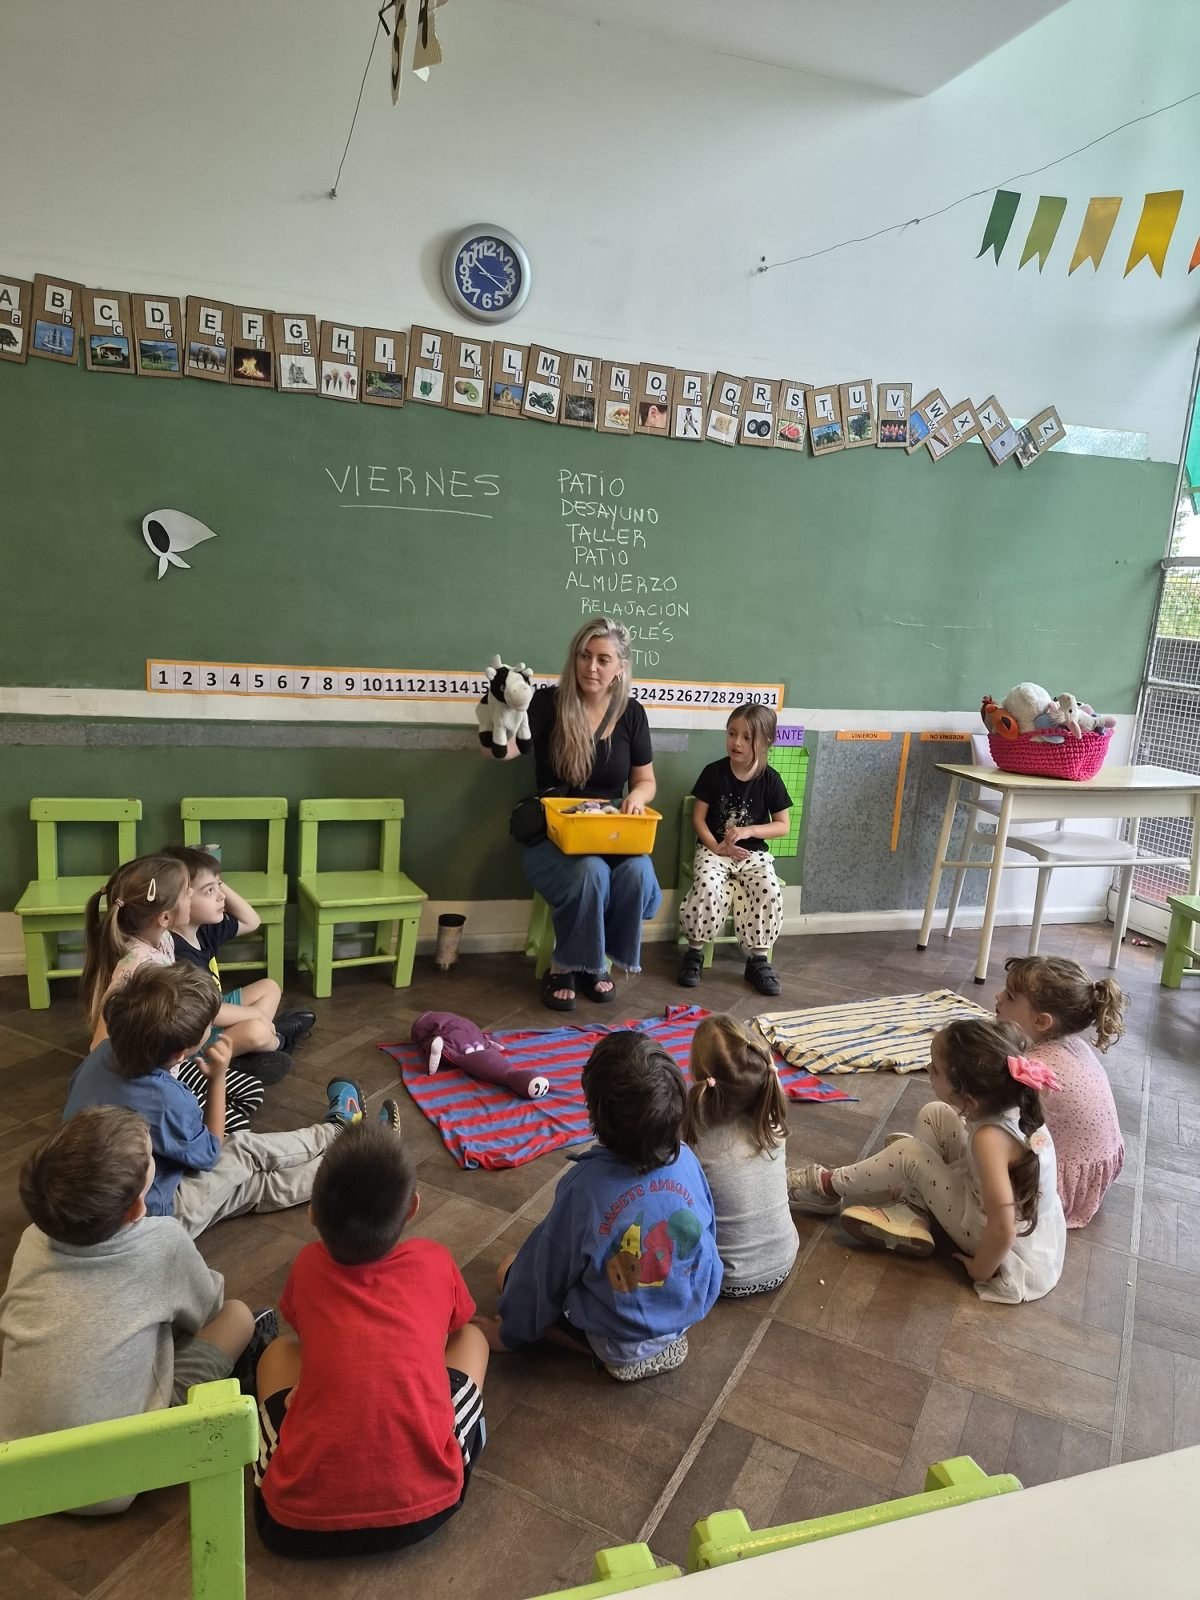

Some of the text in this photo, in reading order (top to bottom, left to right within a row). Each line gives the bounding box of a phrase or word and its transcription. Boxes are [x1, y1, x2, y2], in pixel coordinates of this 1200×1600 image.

[470, 242, 483, 259] 11
[482, 240, 497, 257] 12
[496, 246, 504, 261] 1
[460, 250, 475, 267] 10
[504, 256, 513, 272] 2
[459, 264, 470, 279] 9
[506, 268, 515, 285] 3
[462, 278, 472, 293] 8
[471, 288, 481, 303] 7
[482, 292, 492, 309] 6
[494, 290, 504, 306] 5
[0, 289, 13, 306] A
[52, 292, 65, 308] B
[100, 305, 113, 320] C
[152, 308, 164, 323] D
[205, 314, 216, 329] E
[248, 320, 258, 334] F
[290, 324, 302, 338] G
[338, 334, 349, 349] H
[427, 340, 436, 354] J
[465, 349, 475, 364] K
[508, 355, 516, 369] L
[542, 357, 554, 374] M
[578, 365, 588, 379] N
[615, 370, 625, 387] Ñ
[651, 377, 662, 390] O
[688, 382, 697, 394] P
[726, 388, 736, 405] Q
[756, 388, 766, 401] R
[791, 394, 800, 406] S
[820, 400, 828, 412] T
[853, 392, 862, 403] U
[890, 394, 900, 407] V
[930, 403, 944, 419] W
[958, 416, 971, 428] X
[983, 412, 992, 424] Y
[1044, 423, 1054, 435] Z
[12, 314, 20, 324] a
[64, 311, 72, 324] b
[114, 324, 122, 335] c
[166, 326, 173, 339] d
[216, 336, 225, 346] e
[258, 337, 265, 349] f
[303, 341, 311, 354] g
[434, 356, 440, 369] j
[476, 366, 481, 377] k
[550, 376, 560, 386] m
[586, 383, 593, 392] n
[624, 389, 630, 400] ñ
[660, 394, 667, 403] o
[696, 394, 702, 405] p
[829, 411, 834, 420] t
[326, 466, 500, 498] VIERNES
[558, 469, 625, 497] PATIO
[561, 498, 659, 530] DESAYUNO
[565, 524, 646, 549] TALLER
[574, 546, 629, 566] PATIO
[565, 571, 678, 594] ALMUERZO
[628, 621, 674, 642] GLÉS
[630, 649, 660, 667] TIO
[158, 670, 169, 685] 1
[182, 672, 193, 686] 2
[206, 672, 217, 687] 3
[230, 674, 241, 687] 4
[254, 674, 264, 688] 5
[278, 675, 288, 689] 6
[300, 676, 310, 690] 7
[322, 678, 333, 691] 8
[345, 678, 355, 691] 9
[363, 678, 382, 692] 10
[385, 678, 404, 692] 11
[407, 680, 426, 692] 12
[428, 680, 447, 693] 13
[450, 680, 470, 694] 14
[472, 682, 489, 694] 15
[640, 688, 656, 700] 24
[658, 689, 674, 701] 25
[676, 690, 692, 702] 26
[694, 690, 710, 702] 27
[711, 692, 726, 703] 28
[728, 692, 743, 704] 29
[746, 693, 761, 704] 30
[762, 694, 777, 705] 31
[776, 730, 803, 740] ANTE
